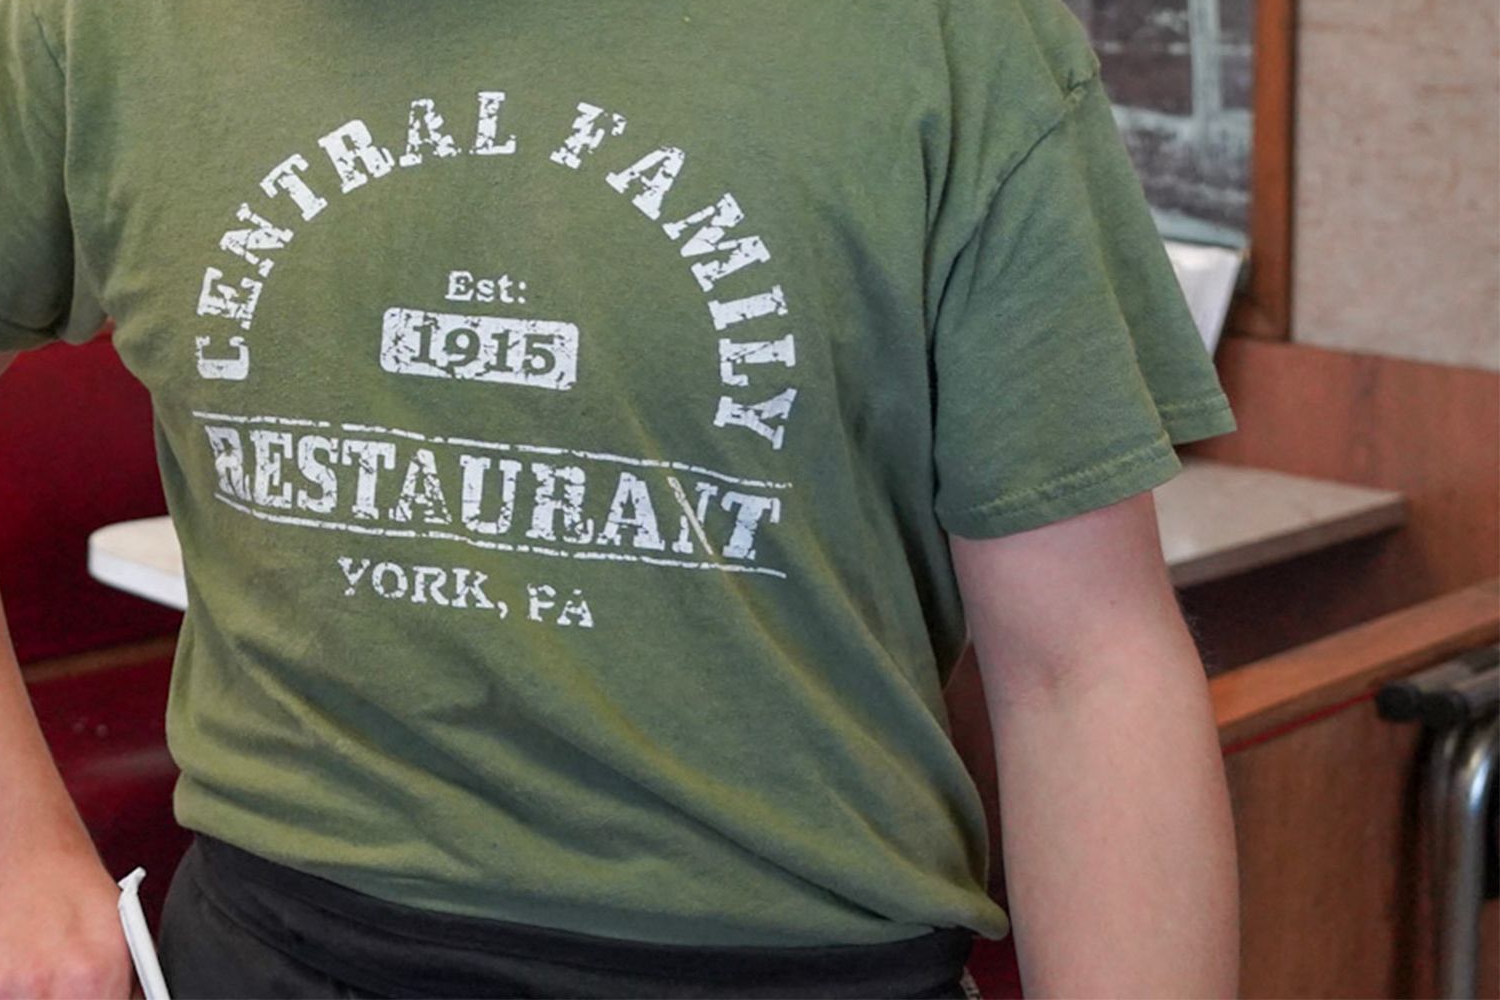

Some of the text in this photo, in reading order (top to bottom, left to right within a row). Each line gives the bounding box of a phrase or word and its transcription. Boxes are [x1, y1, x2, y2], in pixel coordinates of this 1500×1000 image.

[196, 91, 797, 450] CENTRAL FAMILY
[445, 271, 528, 304] Est:
[411, 323, 558, 377] 1915
[204, 424, 782, 561] RESTAURANT
[337, 556, 594, 628] YORK, PA
